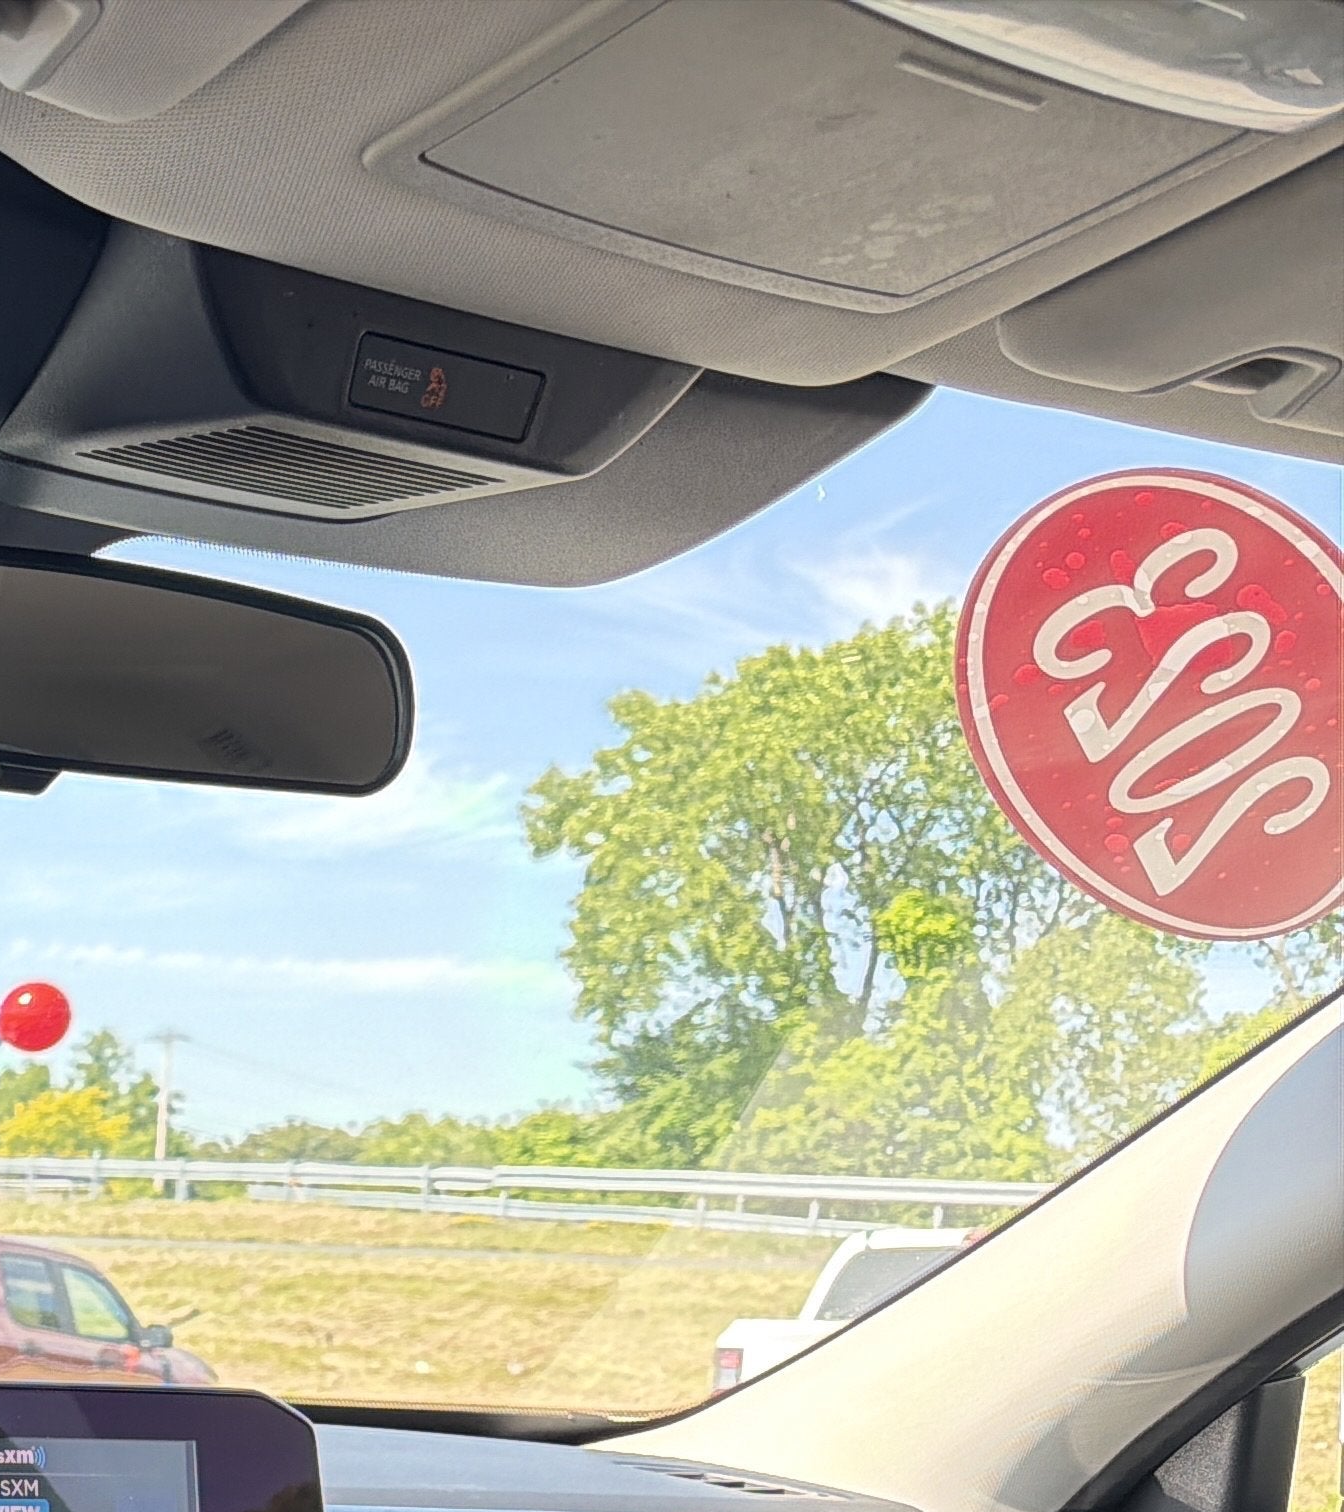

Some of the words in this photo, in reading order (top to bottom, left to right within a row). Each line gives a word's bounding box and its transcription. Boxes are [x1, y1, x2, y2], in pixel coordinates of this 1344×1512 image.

[364, 359, 422, 381] PASSENGER
[368, 374, 386, 388] AIR
[388, 378, 410, 394] BAG
